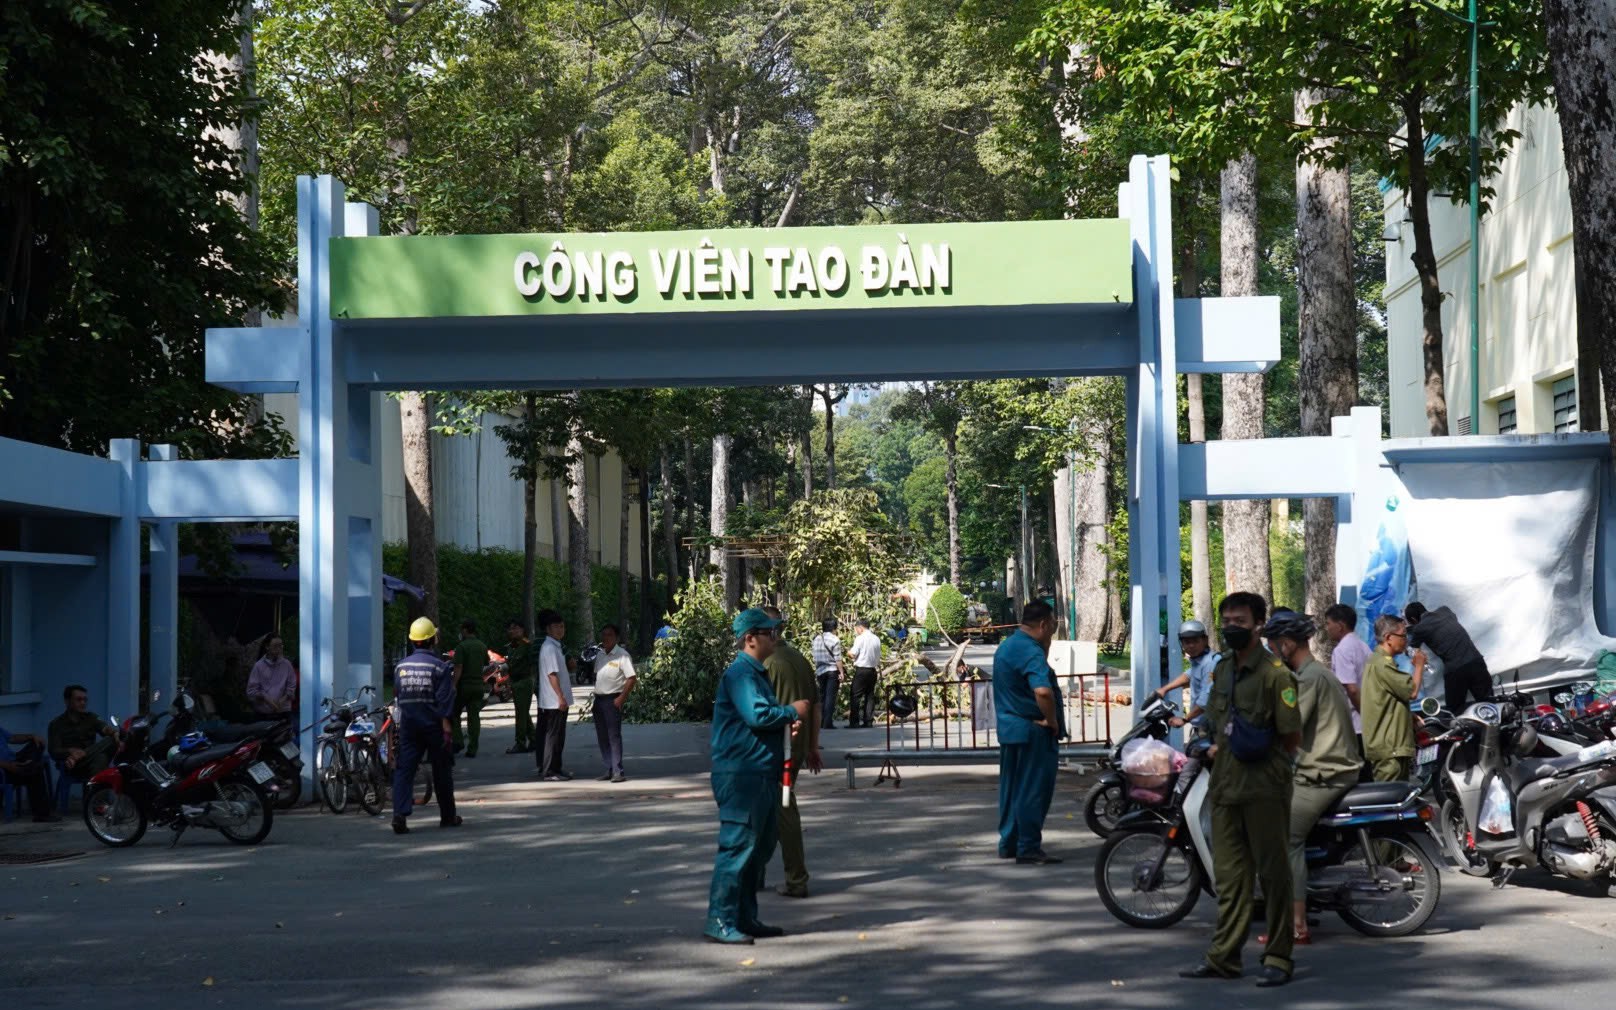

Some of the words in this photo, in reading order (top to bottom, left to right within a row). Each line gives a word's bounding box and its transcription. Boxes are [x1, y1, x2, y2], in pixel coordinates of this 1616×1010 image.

[514, 241, 637, 298] CÔNG
[648, 237, 750, 294] VIÊN
[764, 245, 848, 292] TAO
[860, 232, 950, 291] ĐÀN
